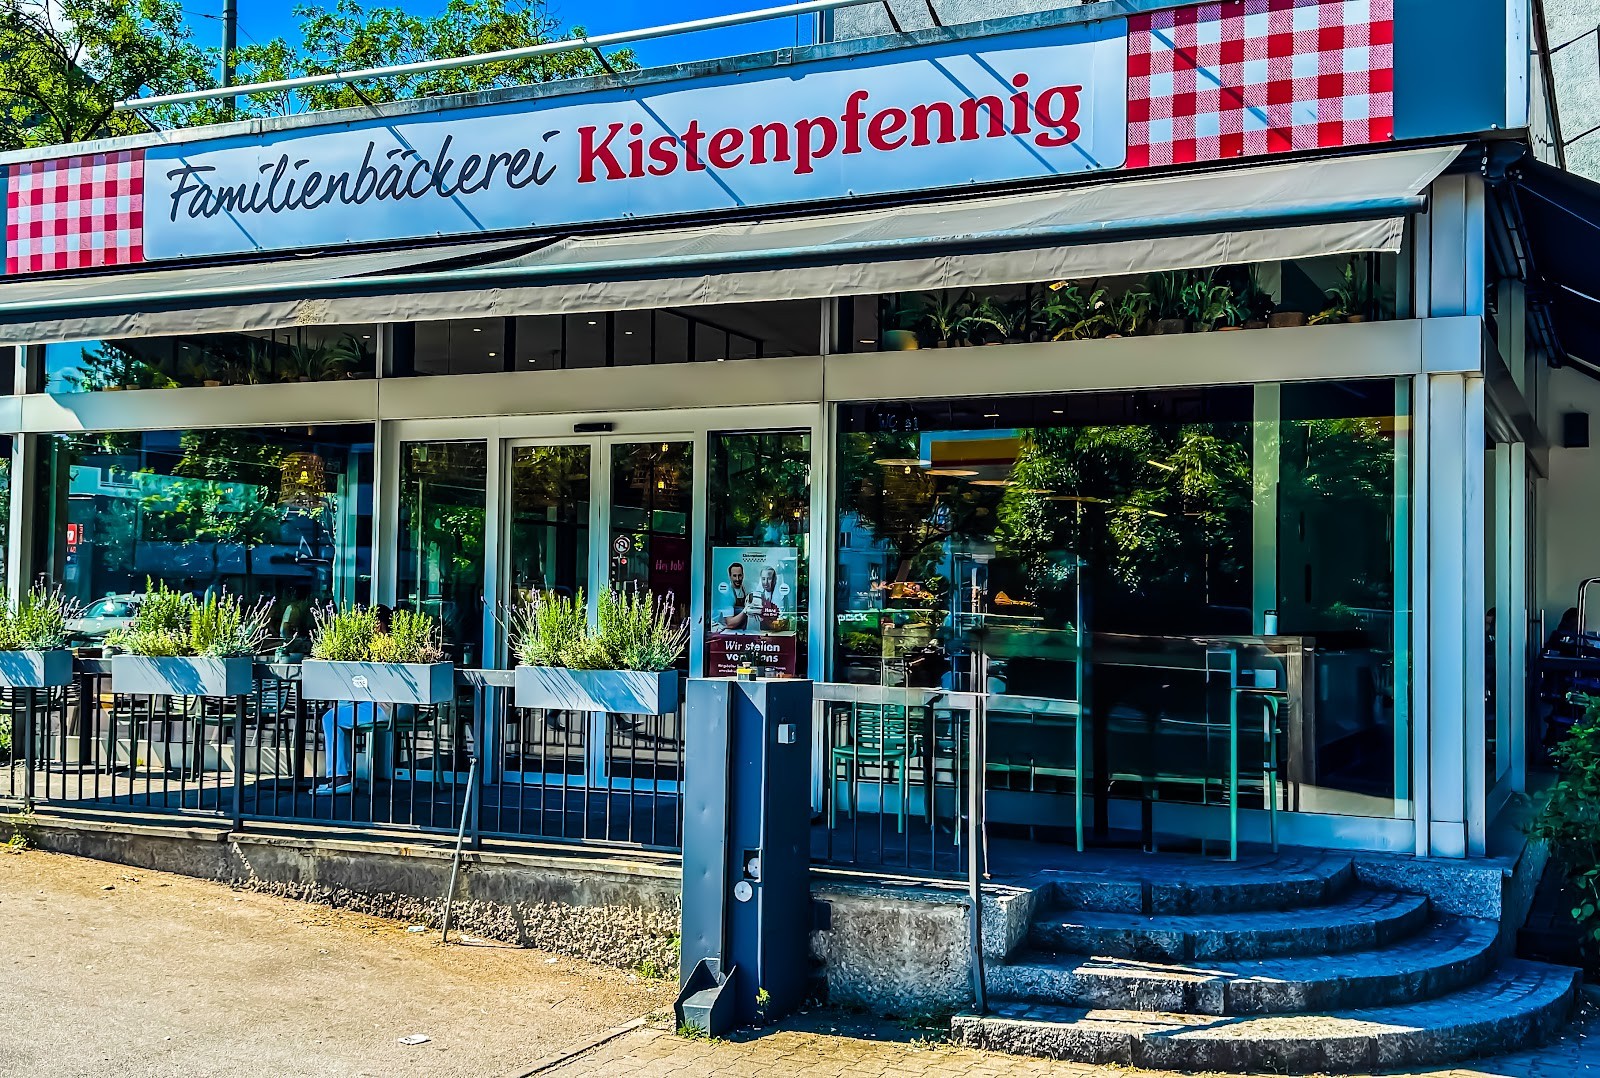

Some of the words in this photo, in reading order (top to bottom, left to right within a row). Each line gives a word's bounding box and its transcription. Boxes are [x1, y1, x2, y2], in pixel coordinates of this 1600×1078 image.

[166, 129, 561, 223] Familienbäckerei
[576, 73, 1083, 185] Kistenpfennig
[725, 640, 742, 650] Wir
